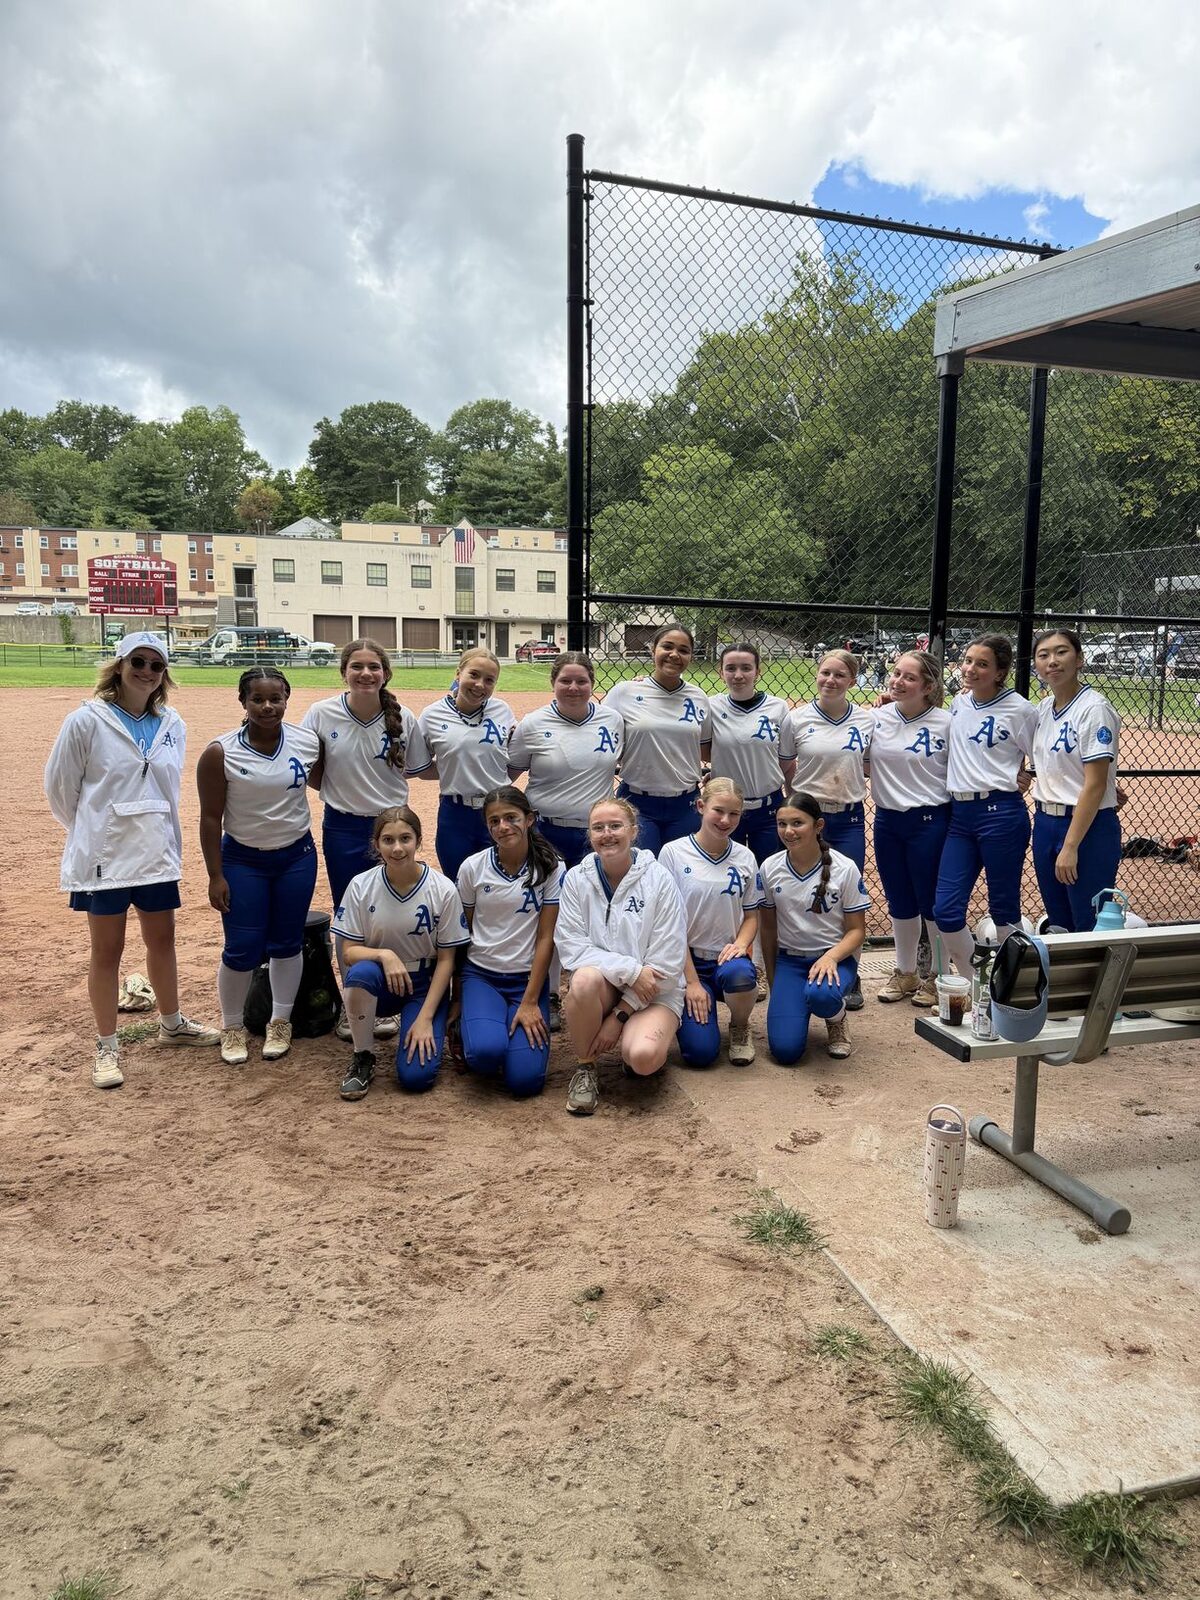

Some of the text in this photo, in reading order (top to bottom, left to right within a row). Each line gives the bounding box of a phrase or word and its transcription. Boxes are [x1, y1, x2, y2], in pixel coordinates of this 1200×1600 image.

[94, 559, 170, 570] SOFTBALL
[678, 698, 705, 726] A's
[478, 718, 507, 746] A's
[594, 725, 619, 753] A's
[842, 726, 870, 754] A's
[905, 727, 946, 758] A's
[969, 715, 1011, 749] A's
[624, 895, 645, 913] A's
